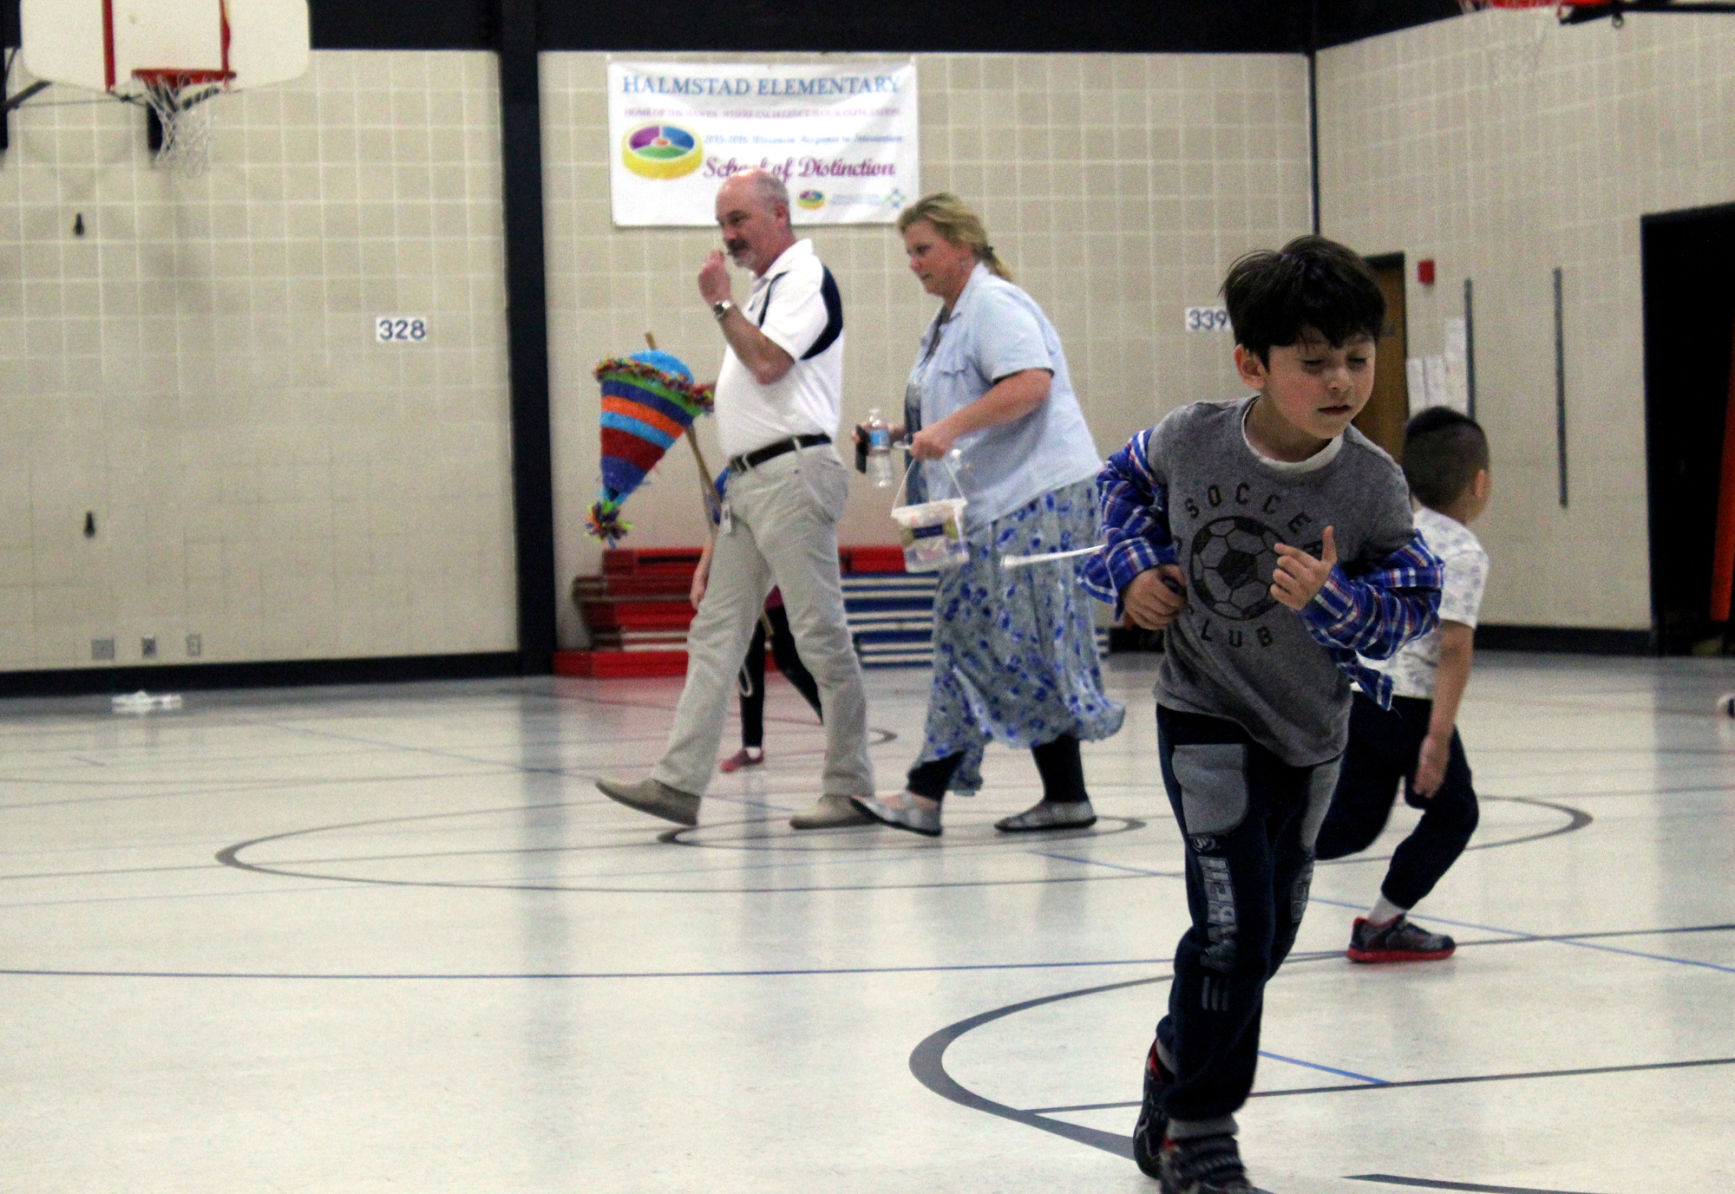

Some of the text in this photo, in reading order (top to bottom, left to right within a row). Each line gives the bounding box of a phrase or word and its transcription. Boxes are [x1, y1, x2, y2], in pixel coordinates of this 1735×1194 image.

[622, 75, 900, 97] HALMSTAD ELEMENTARY
[703, 155, 896, 184] Schl of Distinction
[379, 319, 425, 340] 328
